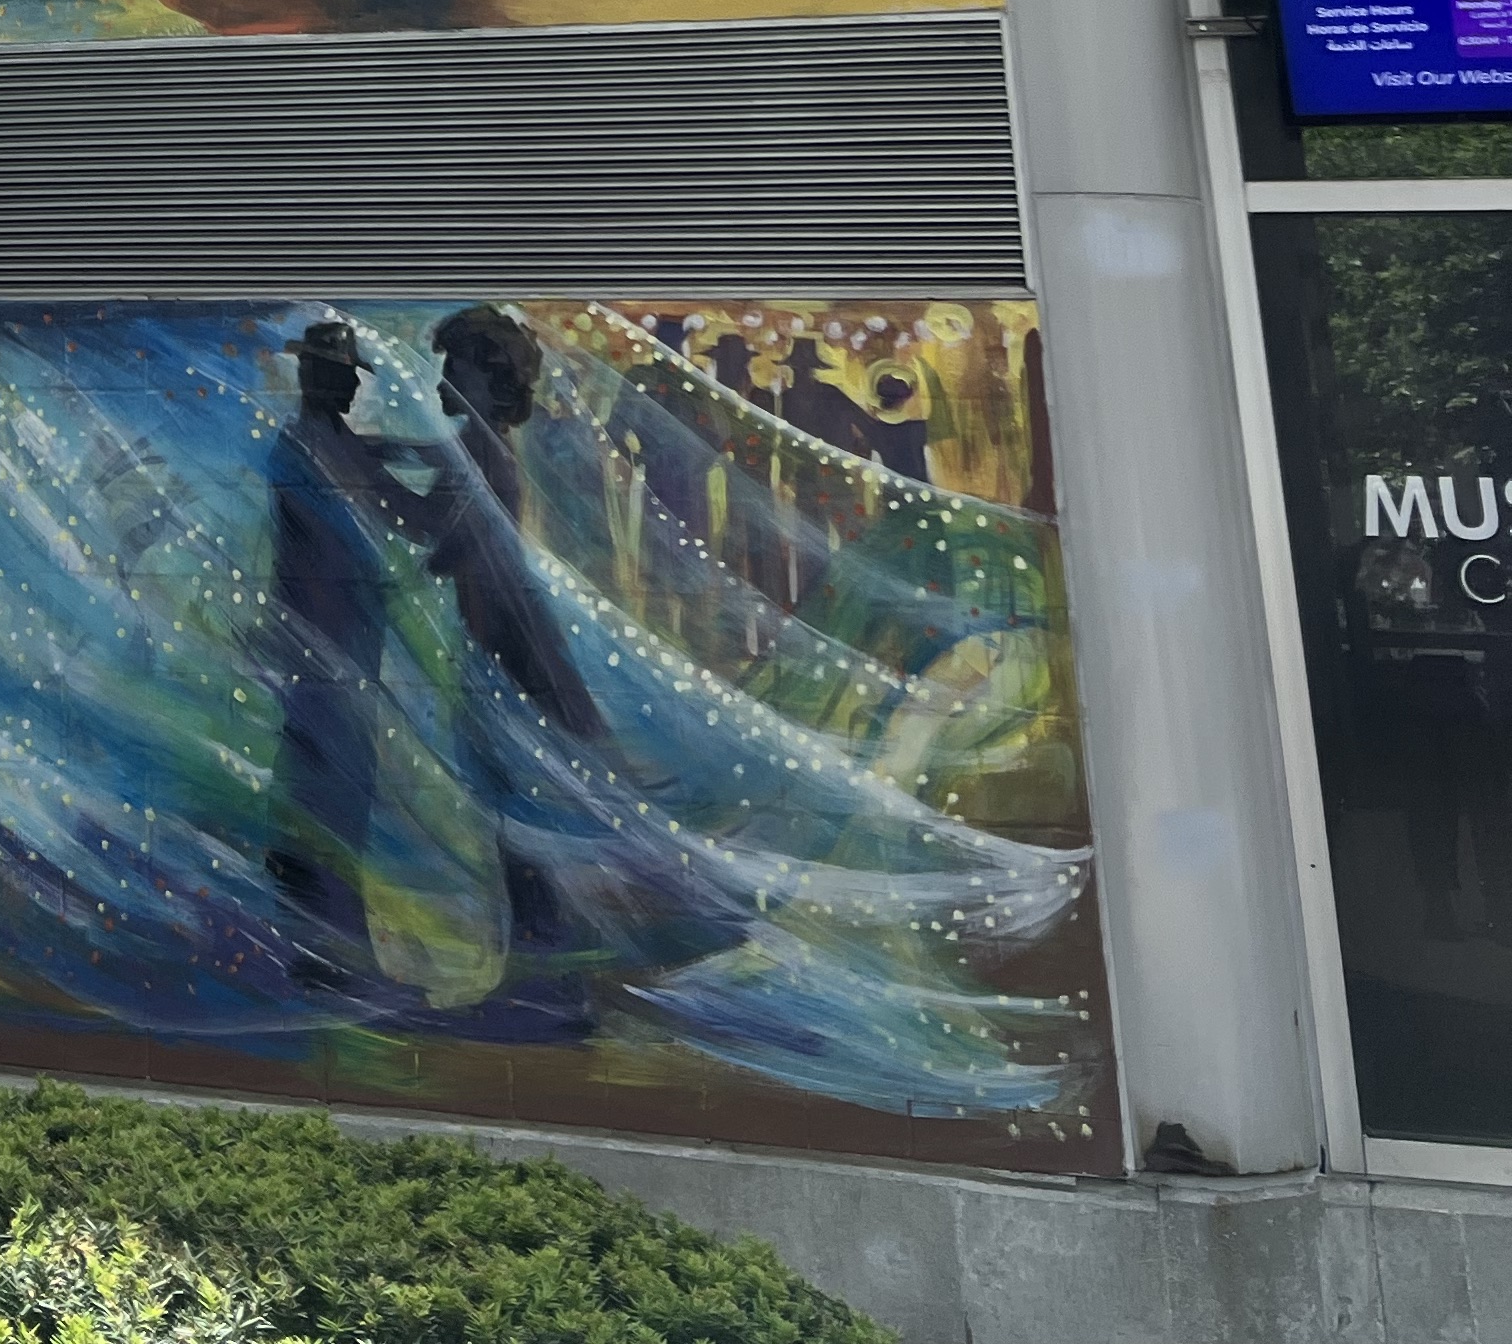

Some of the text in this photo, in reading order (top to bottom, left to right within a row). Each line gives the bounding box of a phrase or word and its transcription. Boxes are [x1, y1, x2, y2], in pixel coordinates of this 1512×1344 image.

[1315, 4, 1414, 18] Service Hours
[1306, 19, 1429, 35] Horas de Servicio
[1370, 70, 1414, 87] Visit
[1416, 70, 1455, 86] Our
